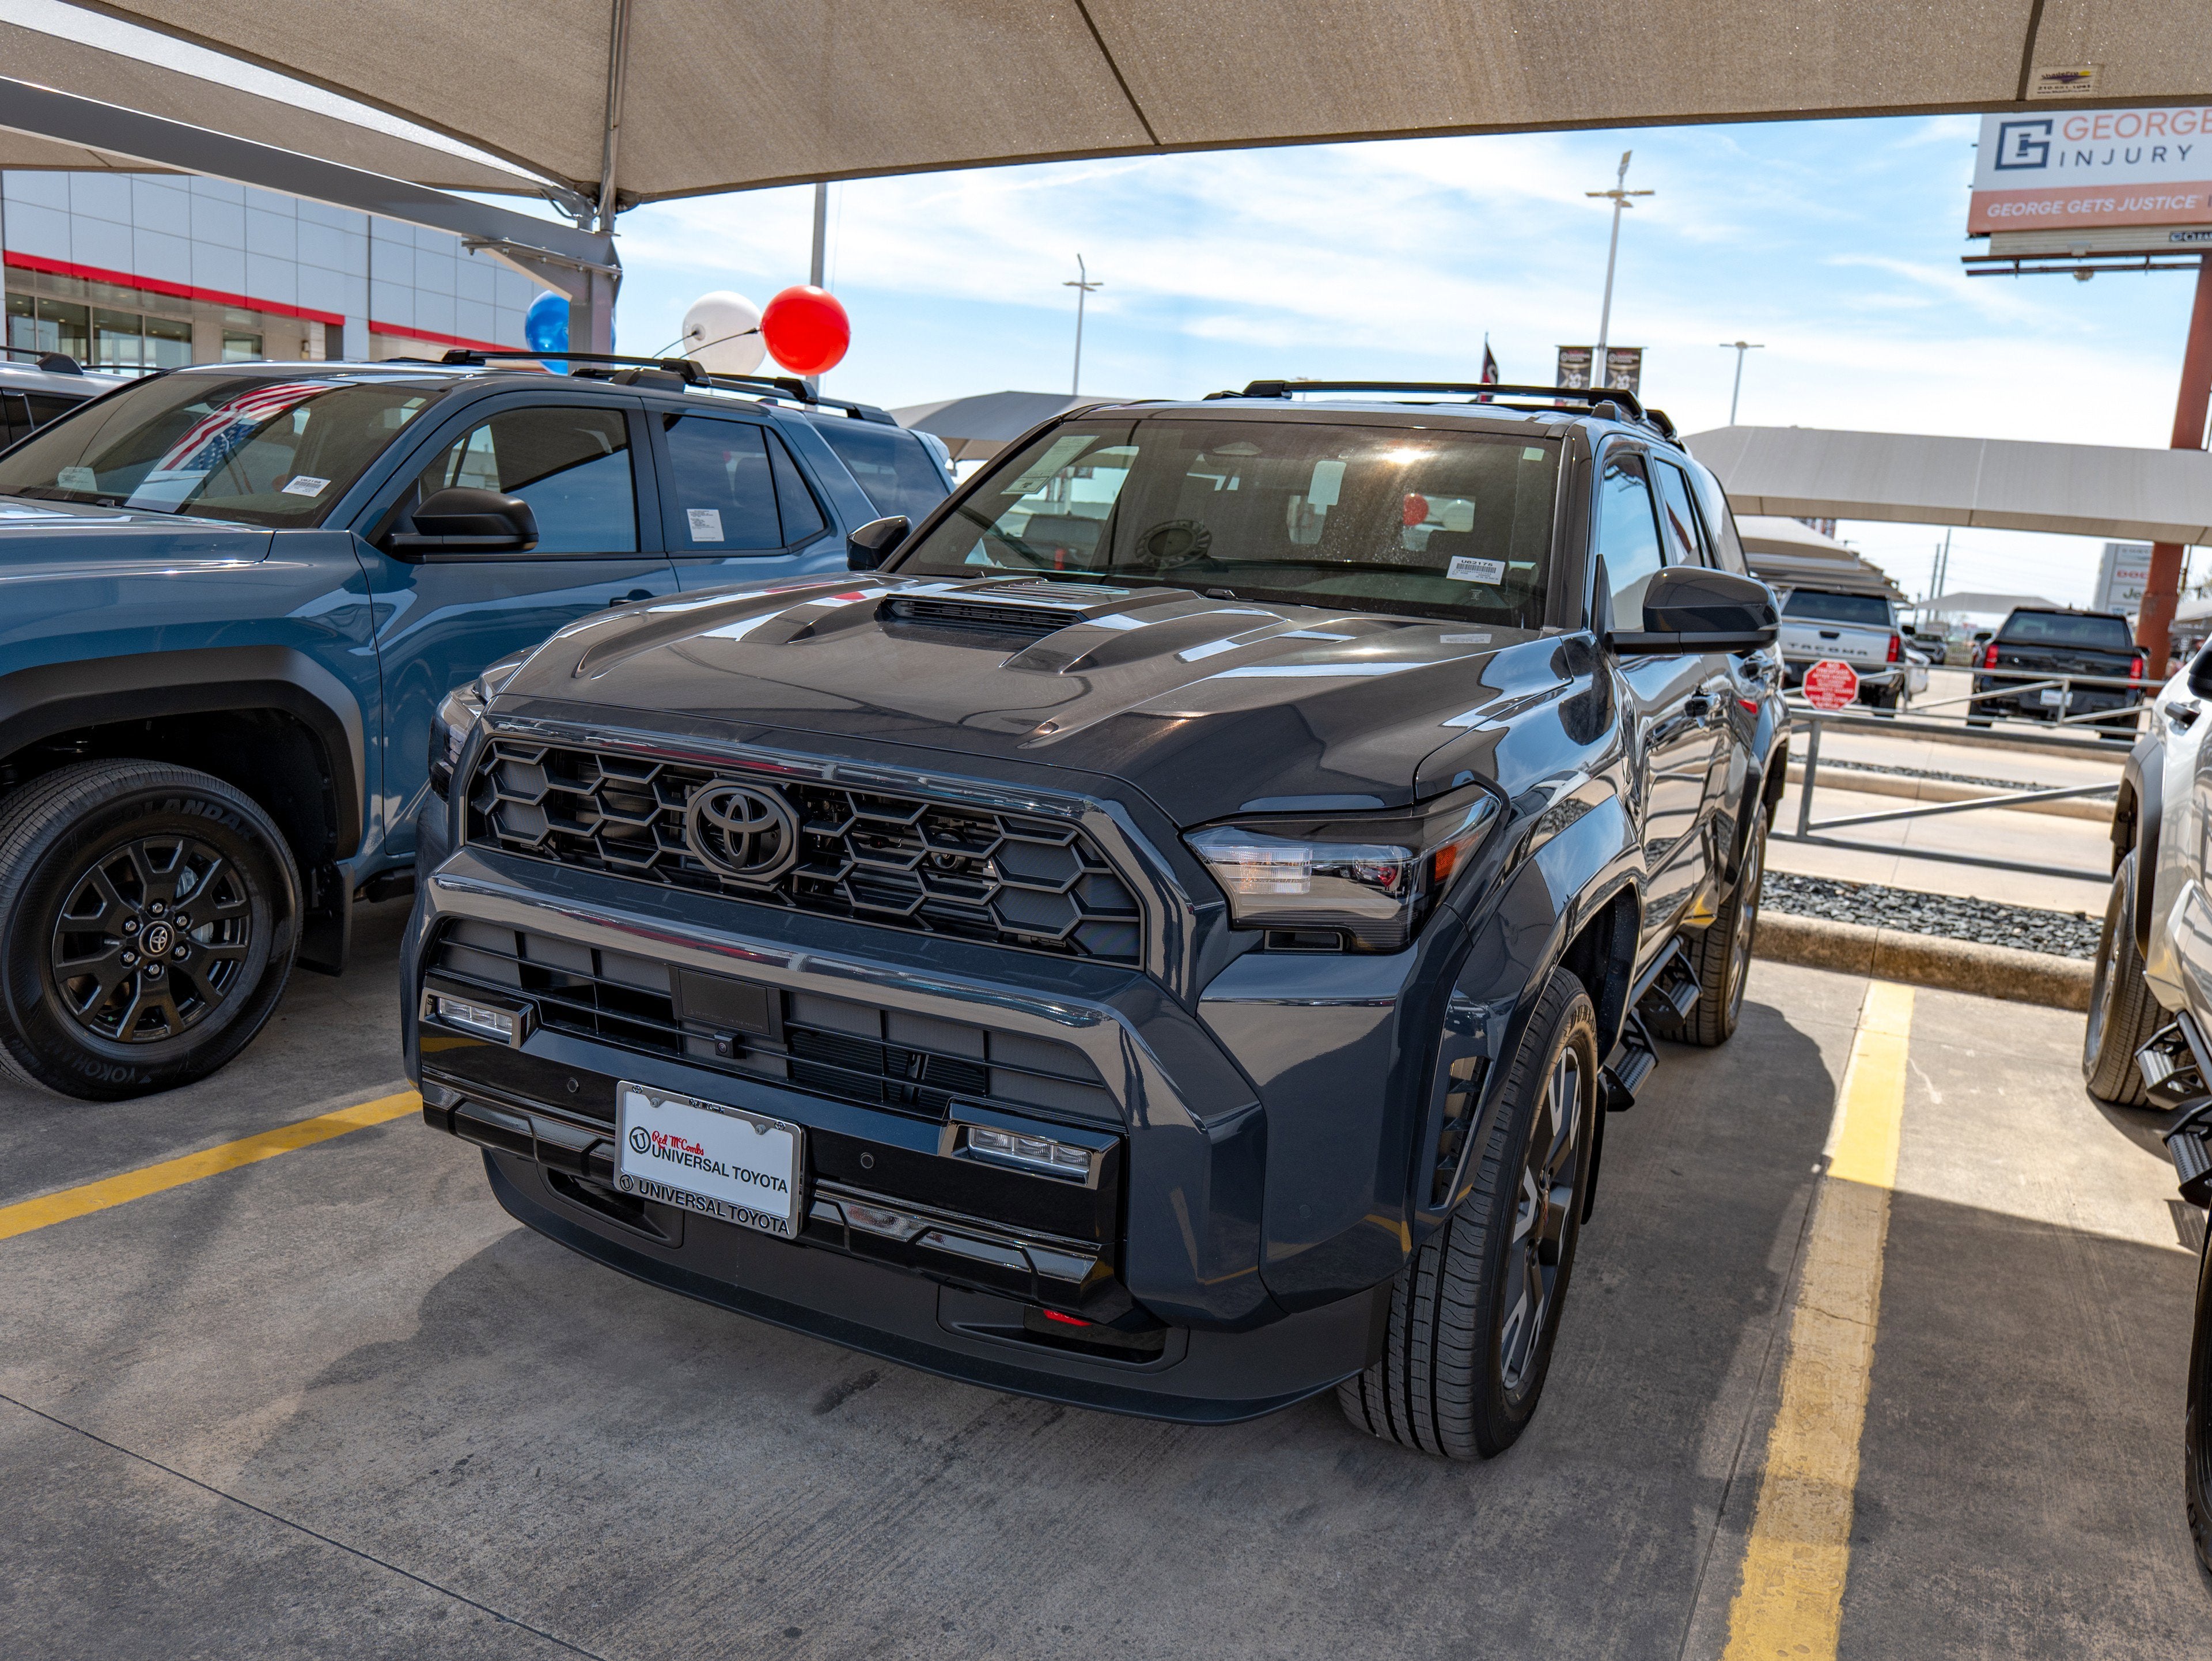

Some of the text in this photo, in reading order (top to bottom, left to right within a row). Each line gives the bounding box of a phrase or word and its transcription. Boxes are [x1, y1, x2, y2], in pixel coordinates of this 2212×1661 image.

[2062, 108, 2212, 142] GEORGE
[2059, 144, 2194, 167] INJURY
[1987, 200, 2064, 217] GEORGE
[2067, 198, 2116, 214] GETS
[1788, 642, 1868, 656] TACOMA
[652, 1130, 704, 1156] Red McCombs
[652, 1144, 788, 1194] UNIVERSAL TOYOTA
[639, 1179, 790, 1236] UNIVERSAL TOYOTA
